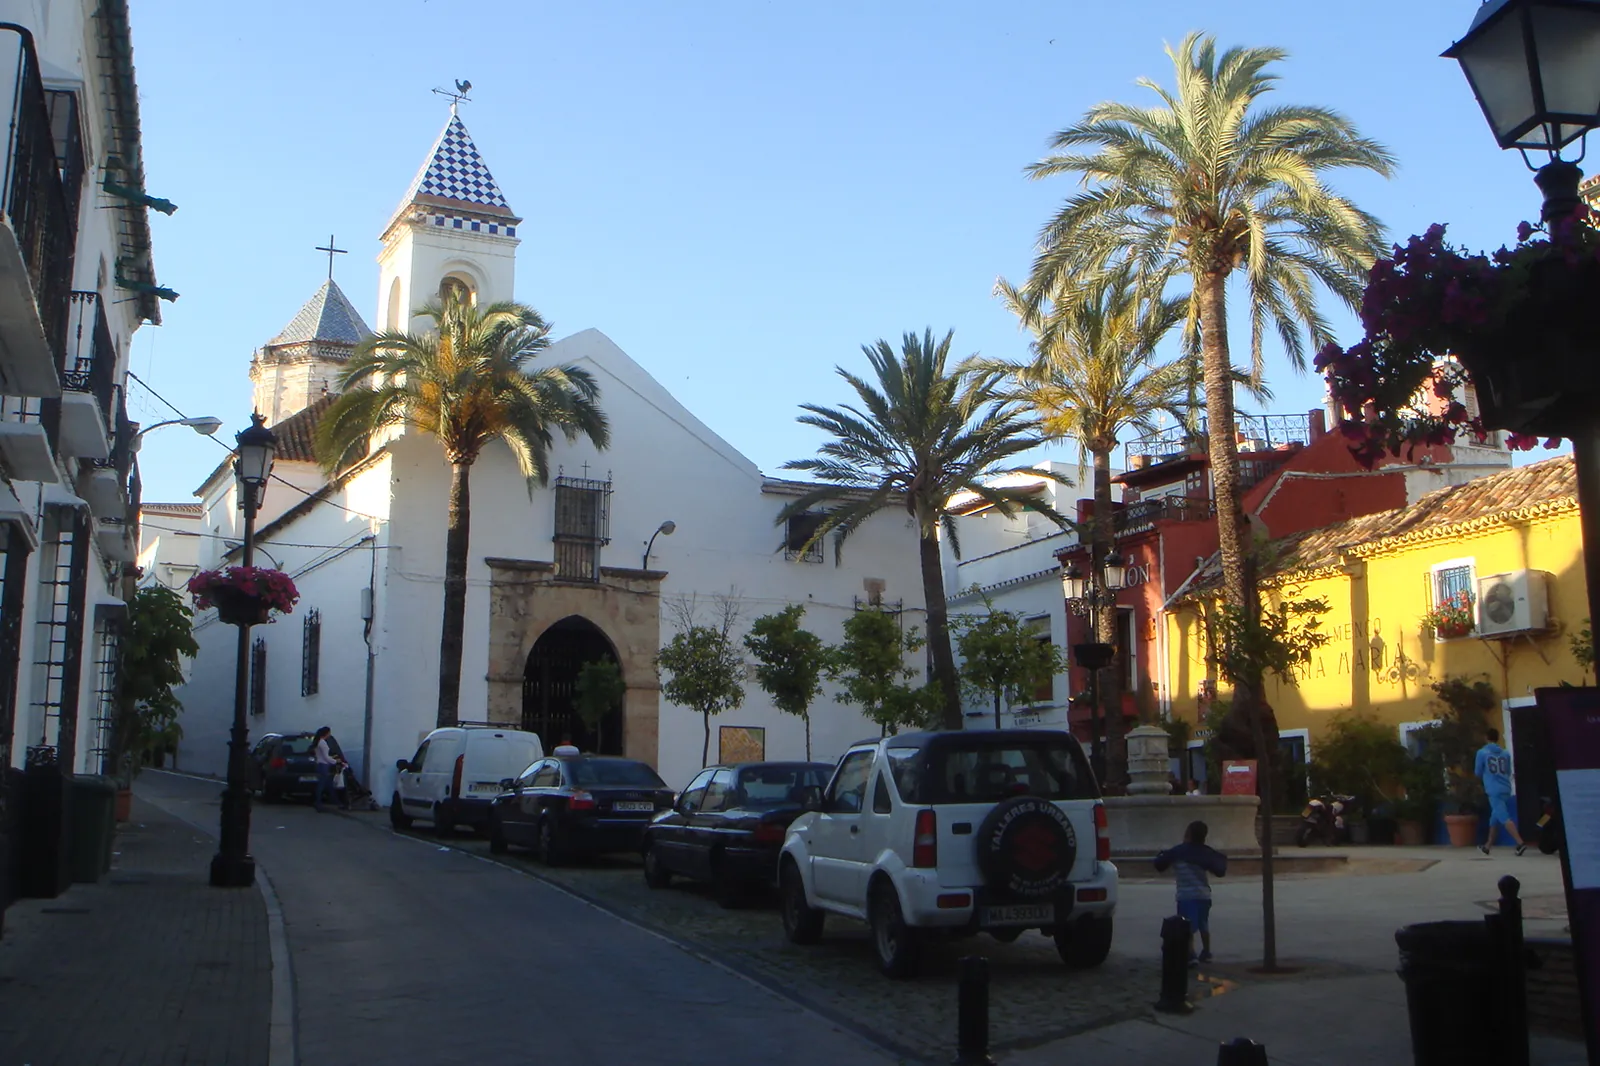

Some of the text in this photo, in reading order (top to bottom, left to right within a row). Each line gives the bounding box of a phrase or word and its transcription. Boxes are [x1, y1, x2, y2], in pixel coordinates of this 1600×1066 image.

[1487, 756, 1508, 775] 60
[990, 801, 1076, 852] TALLERES URBANO
